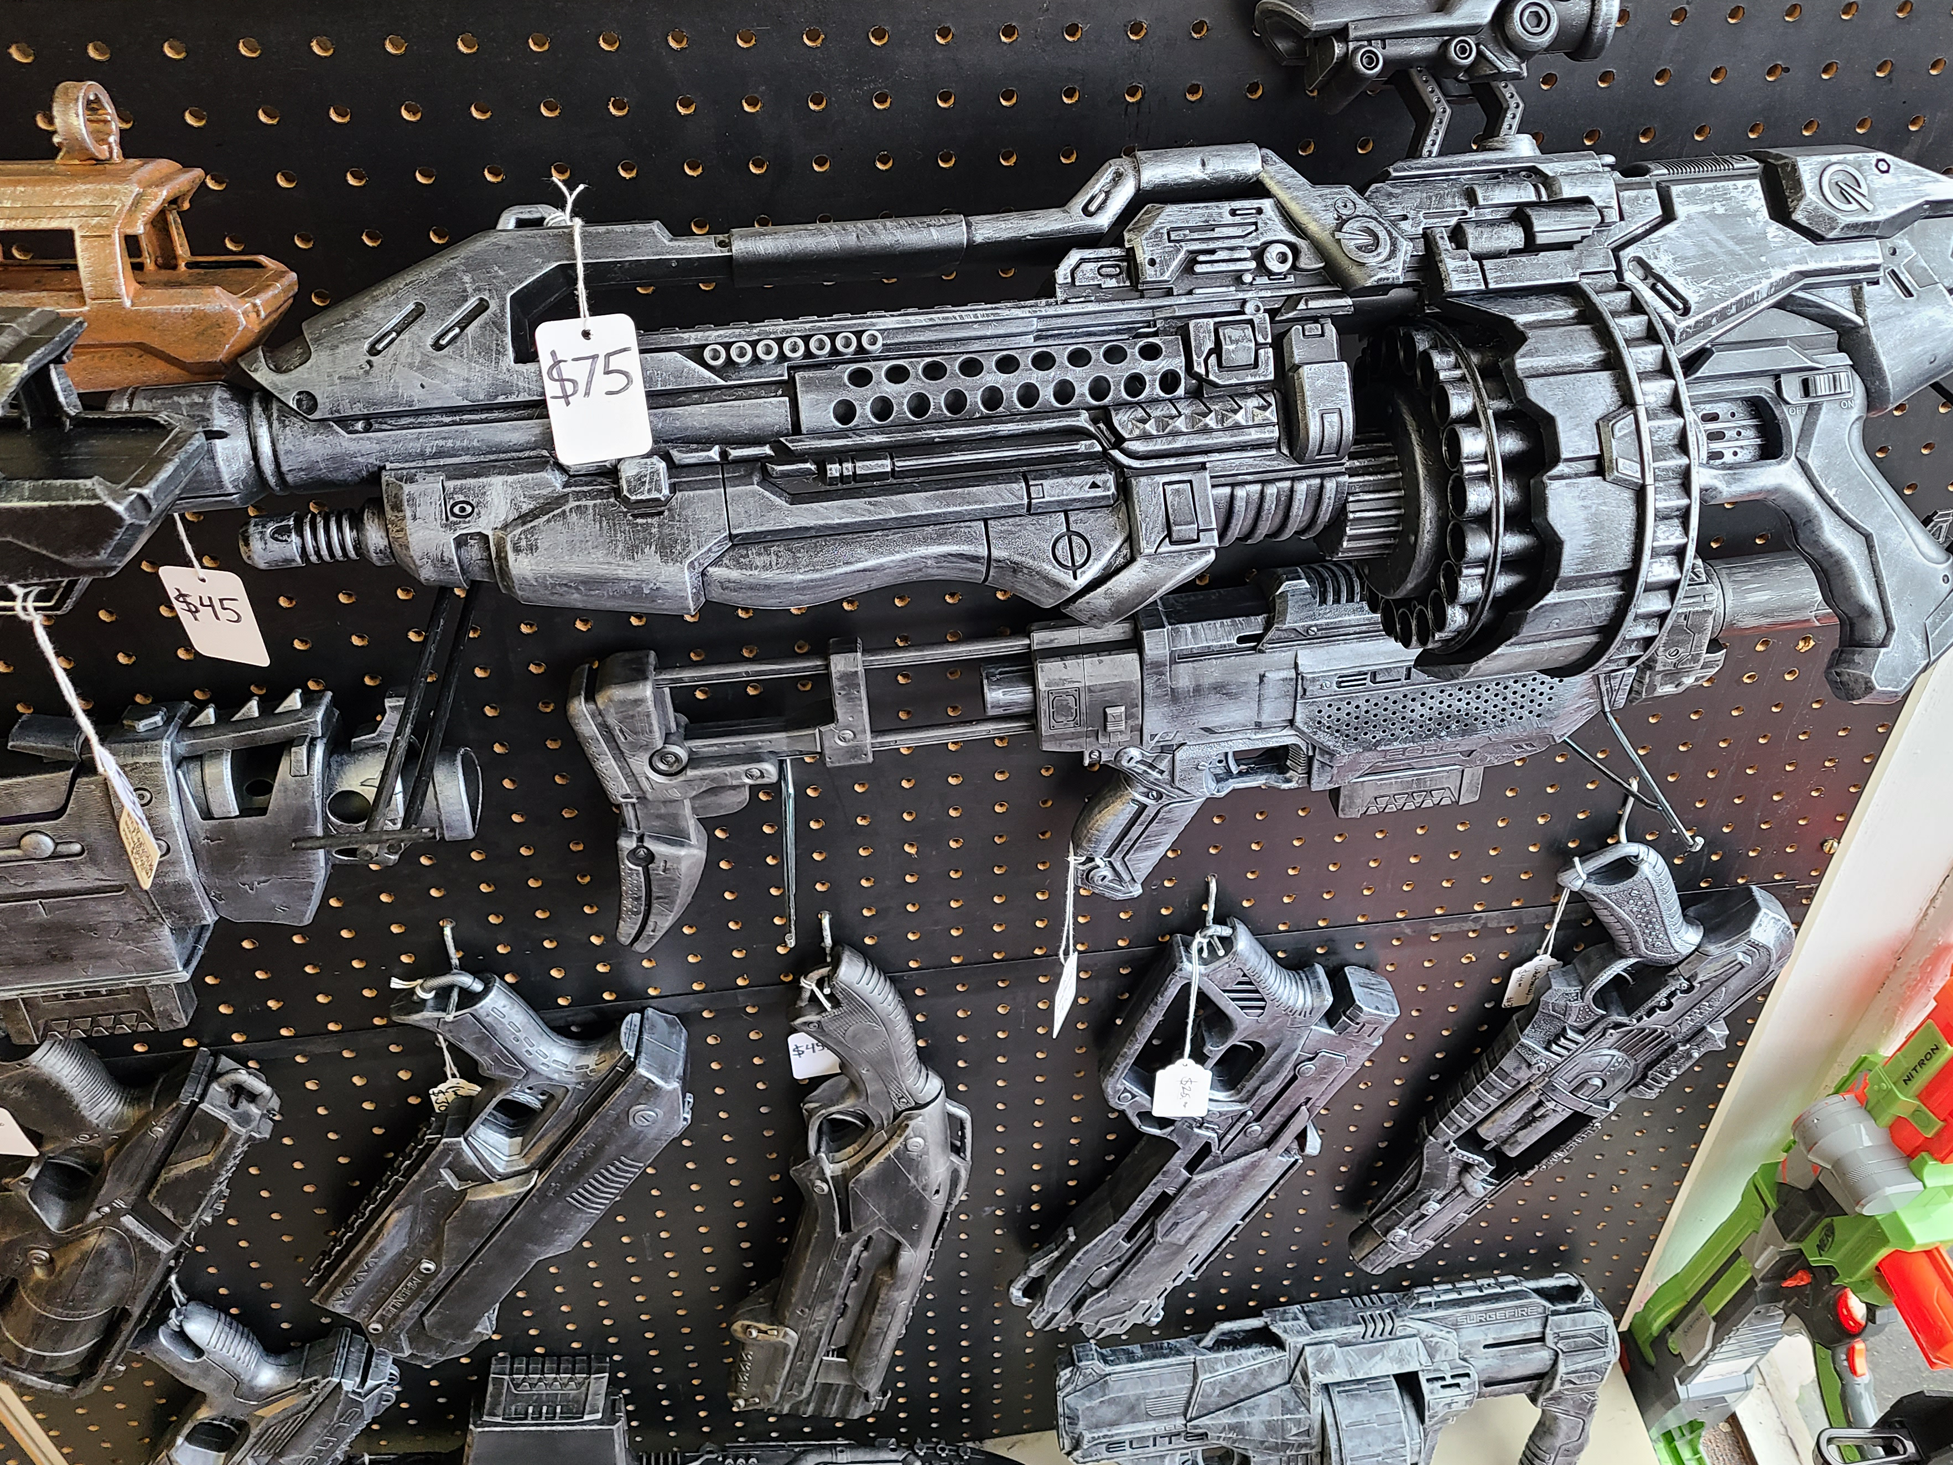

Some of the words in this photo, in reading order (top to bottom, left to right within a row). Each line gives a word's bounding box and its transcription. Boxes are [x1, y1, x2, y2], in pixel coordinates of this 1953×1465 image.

[546, 348, 634, 407] $75
[1840, 400, 1855, 410] ON
[173, 587, 243, 623] $45
[1902, 1043, 1940, 1087] NITRON
[1456, 1305, 1539, 1325] SURGEFIRE
[1105, 1431, 1209, 1454] ELITE
